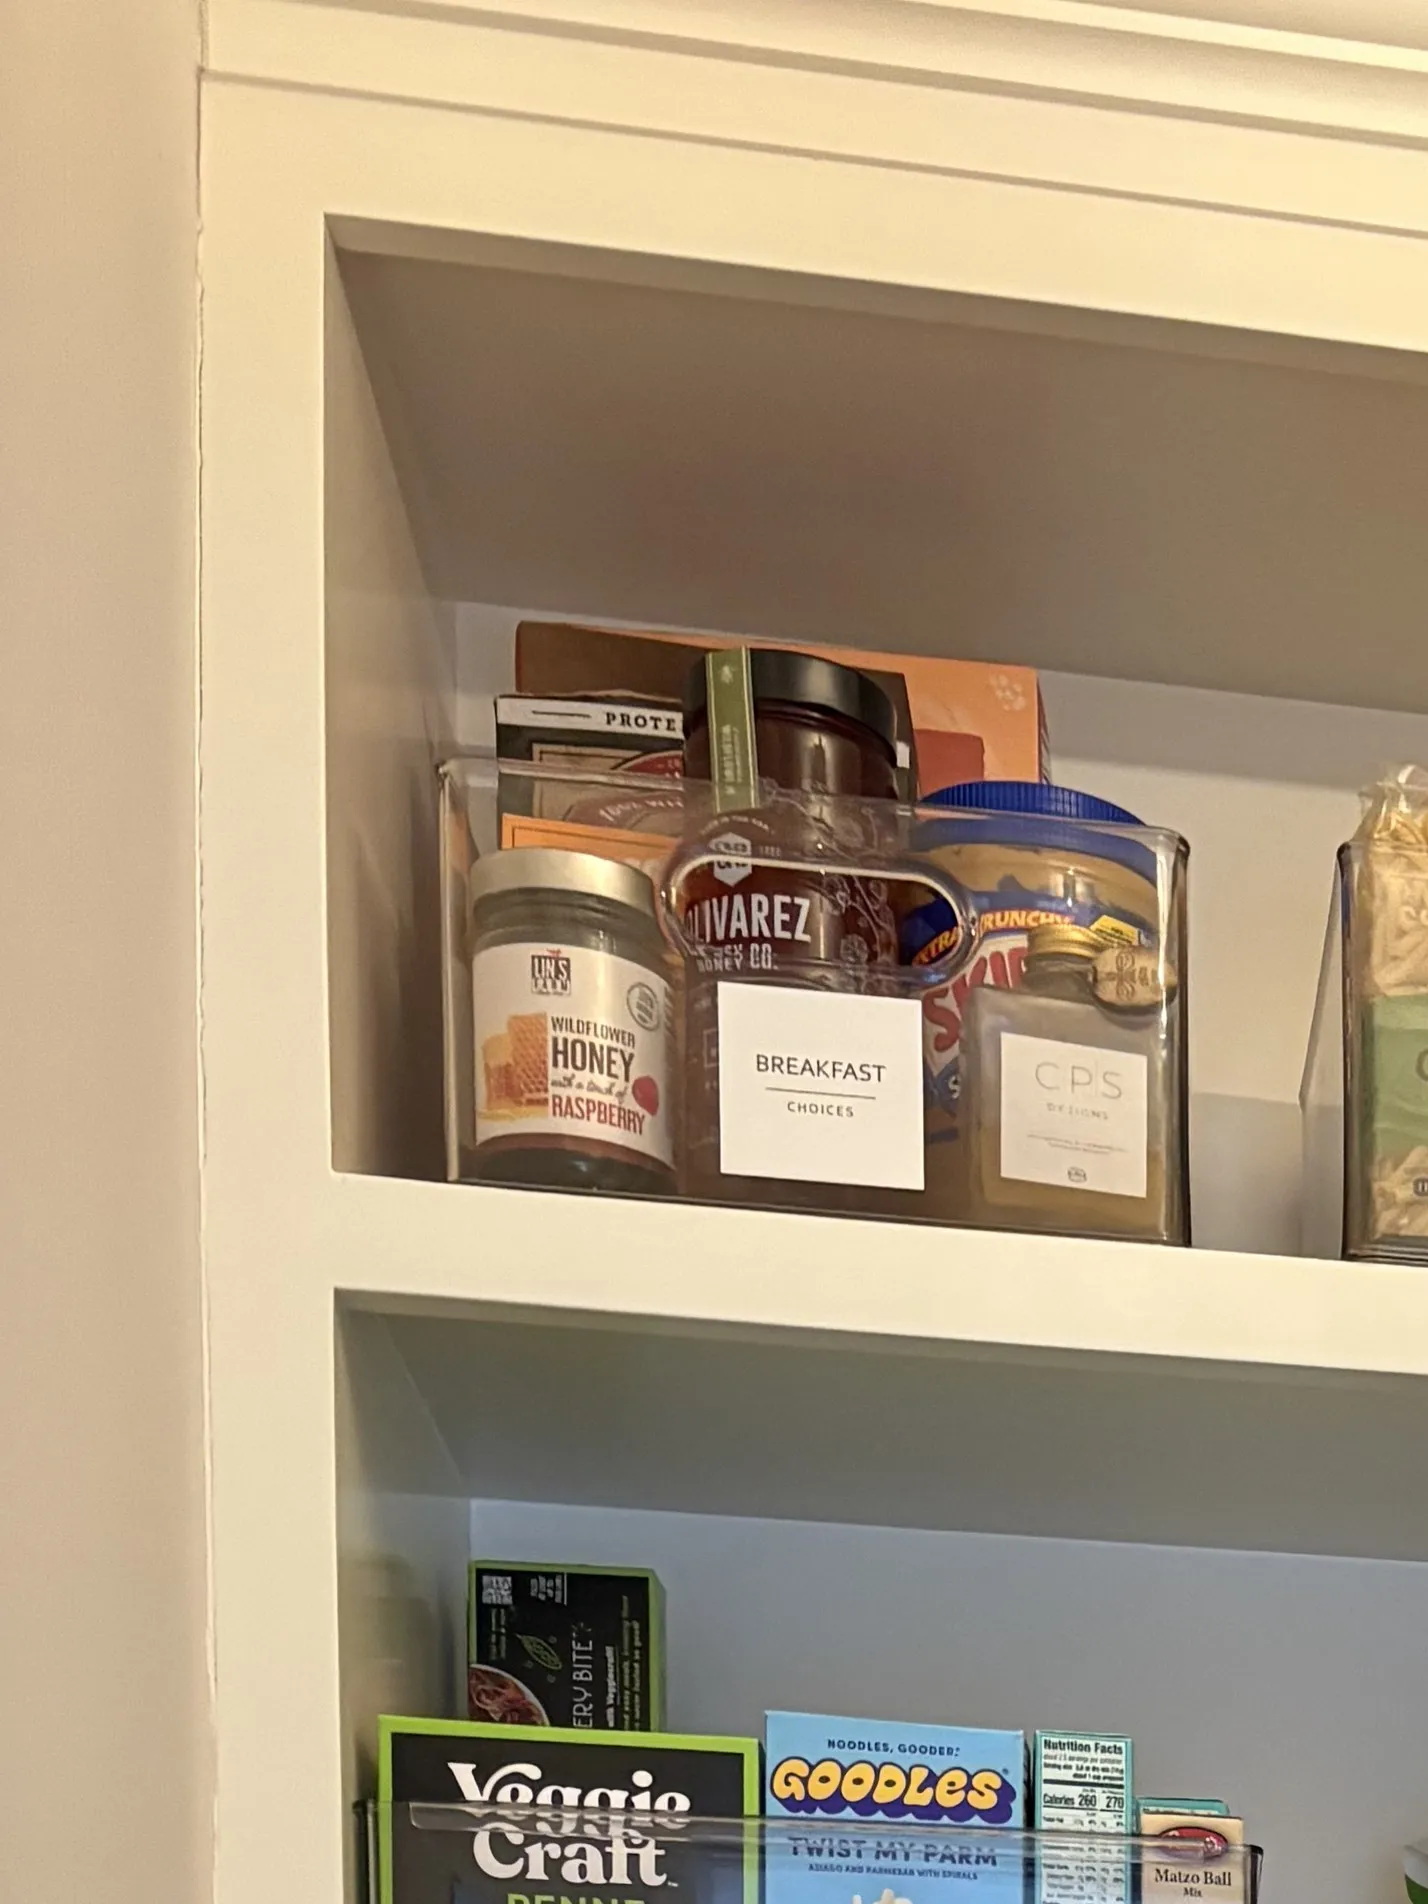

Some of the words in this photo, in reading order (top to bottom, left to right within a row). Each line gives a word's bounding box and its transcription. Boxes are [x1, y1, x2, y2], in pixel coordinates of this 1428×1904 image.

[551, 1016, 636, 1049] WILDFLOWER
[551, 1037, 635, 1083] HONEY
[756, 1053, 887, 1082] BREAKFAST
[552, 1094, 647, 1136] RASPBERRY
[787, 1101, 855, 1117] CHOICES
[1044, 1739, 1092, 1753] Nutrition
[1094, 1741, 1124, 1755] Facts
[447, 1761, 692, 1837] Veggie
[1043, 1792, 1076, 1807] Calories
[1078, 1794, 1098, 1807] 260
[1105, 1795, 1125, 1809] 270
[473, 1822, 668, 1887] Craft
[788, 1835, 868, 1860] TWIST
[874, 1839, 914, 1863] MY
[923, 1843, 998, 1868] PARM
[917, 1868, 941, 1879] WITH
[1155, 1868, 1202, 1886] Matzo
[1204, 1869, 1232, 1887] Ball
